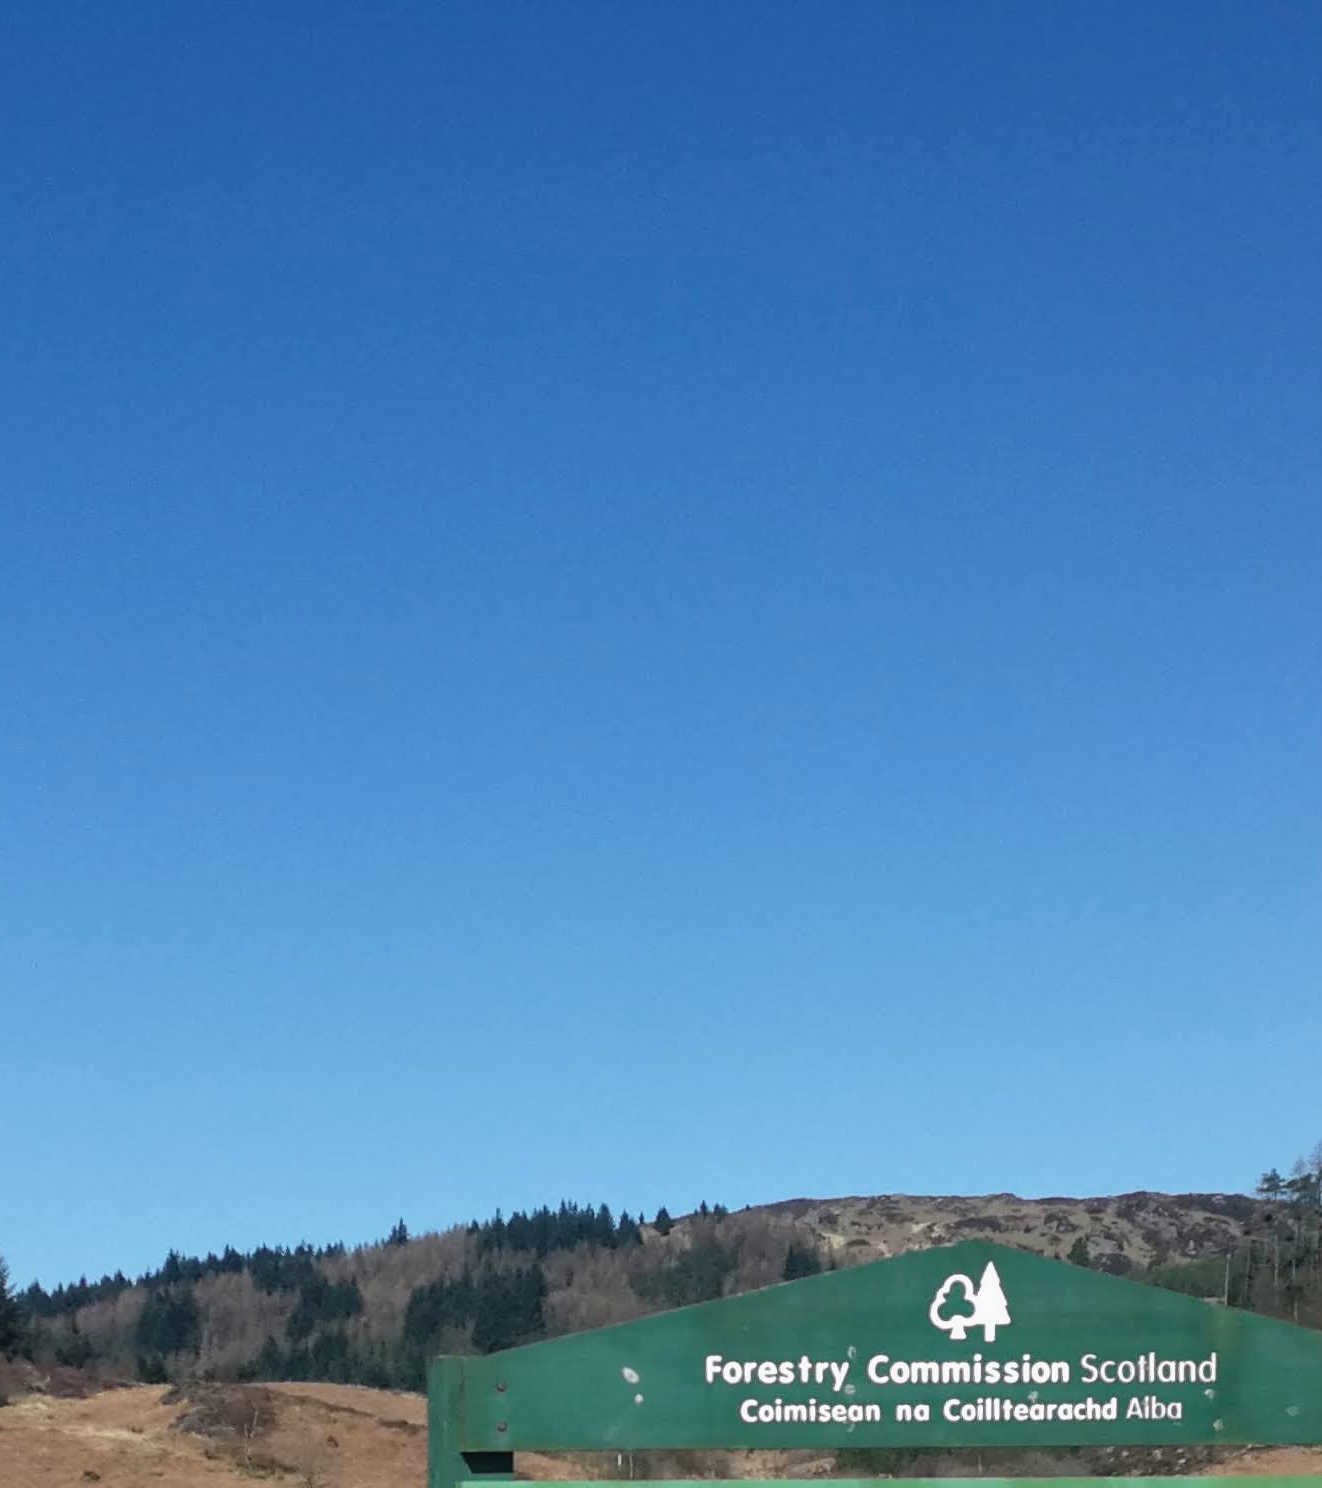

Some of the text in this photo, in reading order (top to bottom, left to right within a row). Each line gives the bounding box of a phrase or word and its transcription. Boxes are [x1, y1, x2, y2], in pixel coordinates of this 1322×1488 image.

[705, 1351, 1217, 1392] Forestry Commission Scotland
[740, 1398, 882, 1423] Coimisean
[895, 1403, 930, 1422] na
[942, 1397, 1118, 1422] Coilltearachd
